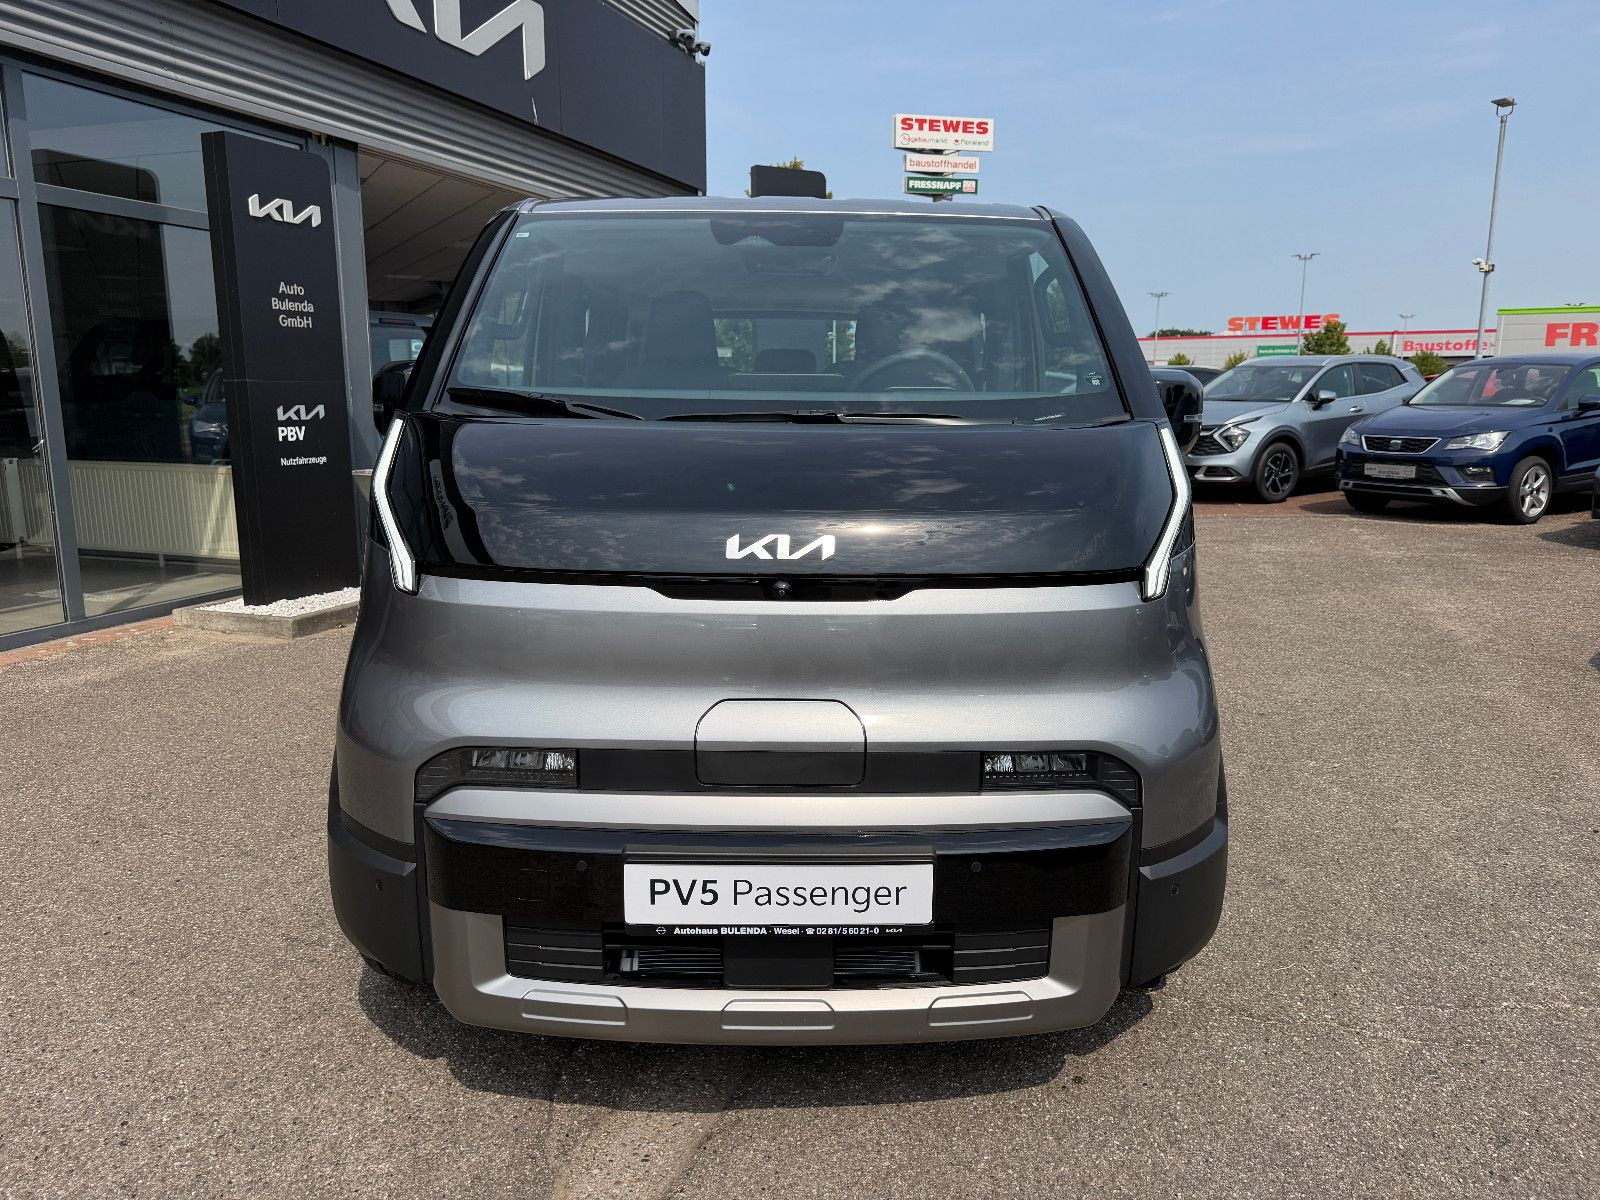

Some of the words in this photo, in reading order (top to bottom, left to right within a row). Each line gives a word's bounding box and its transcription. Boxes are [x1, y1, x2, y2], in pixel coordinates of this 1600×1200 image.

[900, 117, 989, 135] STEWES
[909, 159, 977, 169] baustoffhandel
[909, 179, 962, 190] FRESSNAPF
[249, 193, 322, 228] KIA
[279, 281, 305, 296] Auto
[271, 297, 314, 313] Bulenda
[279, 314, 313, 329] GmbH
[276, 404, 326, 421] KIA
[277, 425, 306, 442] PBV
[280, 455, 328, 466] Nutzfahrzeuge
[725, 533, 836, 561] KIA
[649, 878, 719, 906] PV5
[733, 879, 907, 913] Passenger
[673, 926, 719, 935] Autohaus
[720, 926, 768, 935] BULENDA
[773, 926, 800, 935] Wesel
